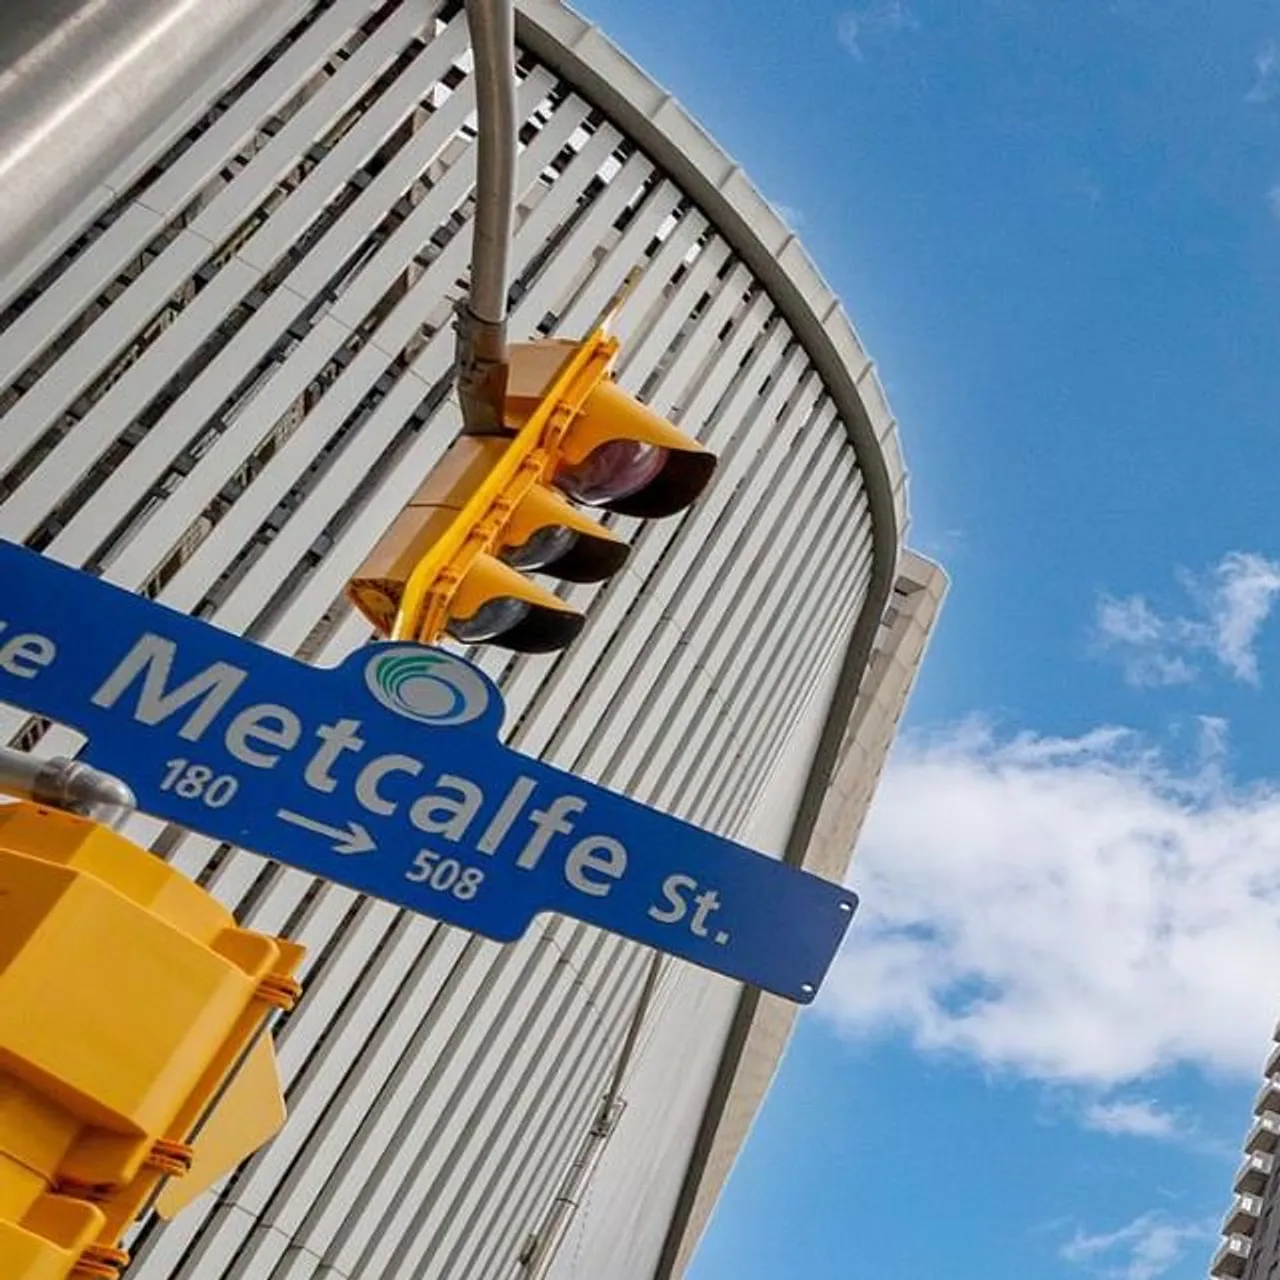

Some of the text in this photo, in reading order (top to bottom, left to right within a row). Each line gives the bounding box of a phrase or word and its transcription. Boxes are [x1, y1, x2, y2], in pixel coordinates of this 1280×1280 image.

[0, 621, 734, 945] e Metcalfe St.
[160, 757, 239, 808] 180
[406, 848, 485, 901] 508
